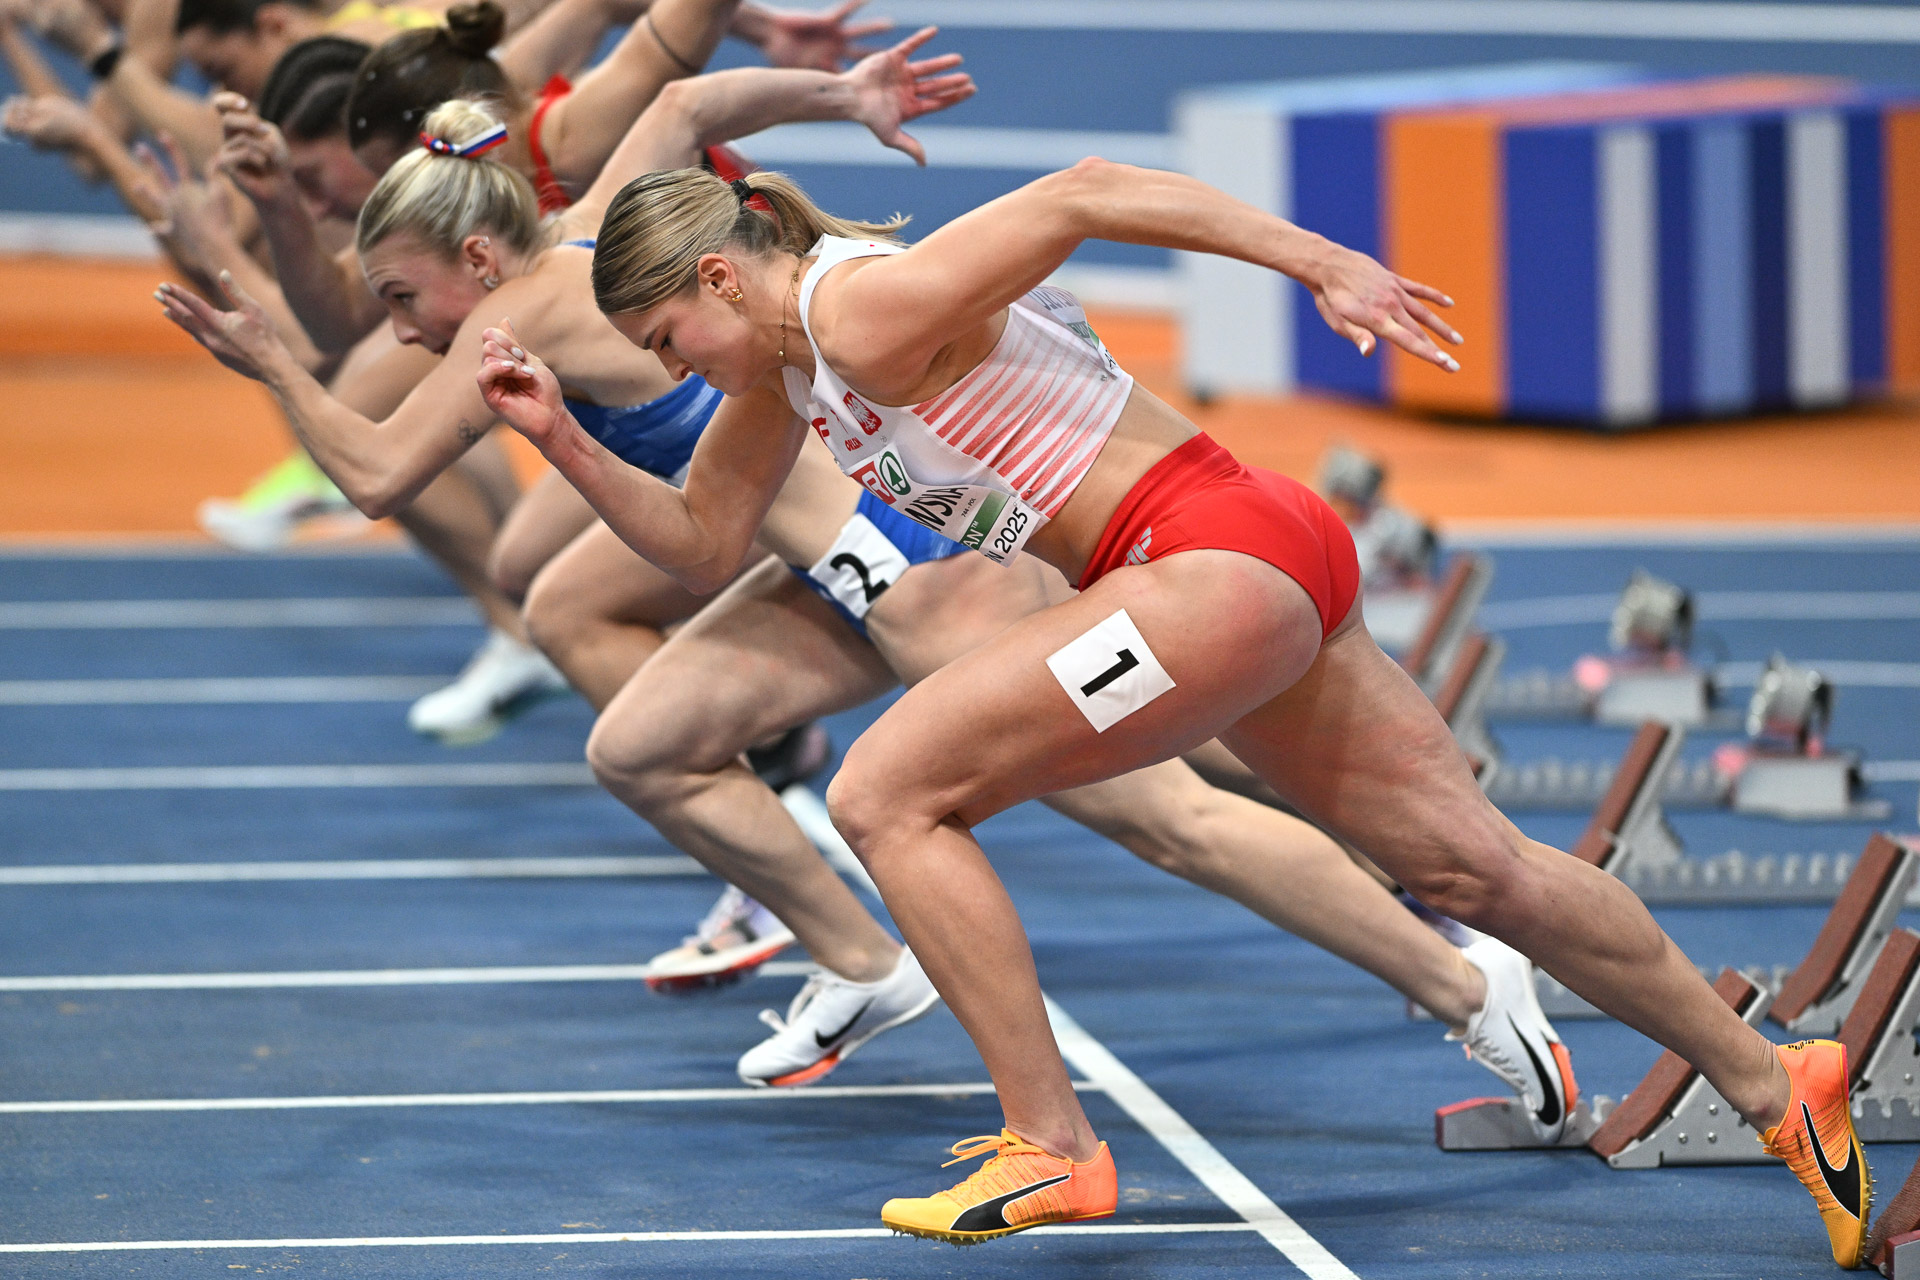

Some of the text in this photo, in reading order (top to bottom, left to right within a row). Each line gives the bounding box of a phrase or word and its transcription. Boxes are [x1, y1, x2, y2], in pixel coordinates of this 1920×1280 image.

[994, 506, 1028, 554] 2025
[830, 553, 890, 604] 2
[1080, 648, 1140, 698] 1
